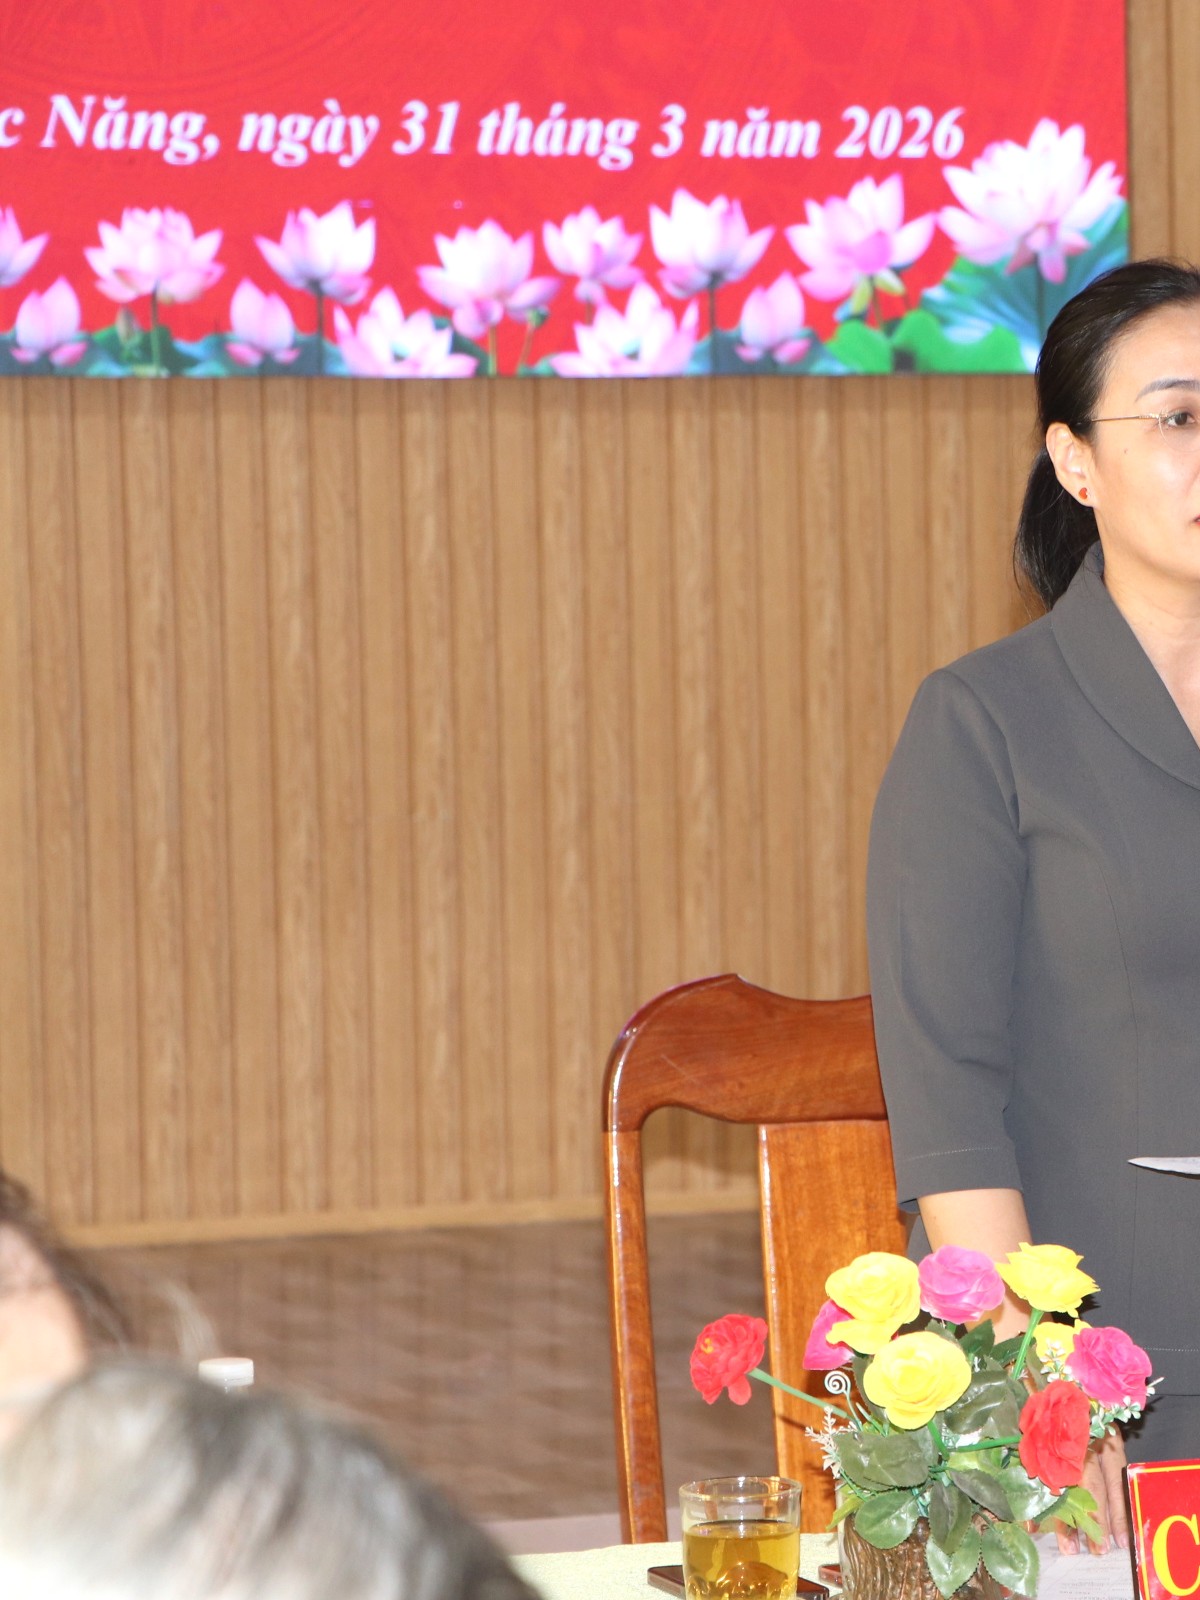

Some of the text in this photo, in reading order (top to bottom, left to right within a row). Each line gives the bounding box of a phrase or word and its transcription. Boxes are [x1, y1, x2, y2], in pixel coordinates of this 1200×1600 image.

[40, 94, 220, 165] Năng,
[238, 98, 380, 168] ngày
[392, 99, 460, 155] 31
[477, 101, 639, 171] tháng
[651, 103, 687, 158] 3
[700, 106, 821, 159] năm
[834, 105, 966, 160] 2026
